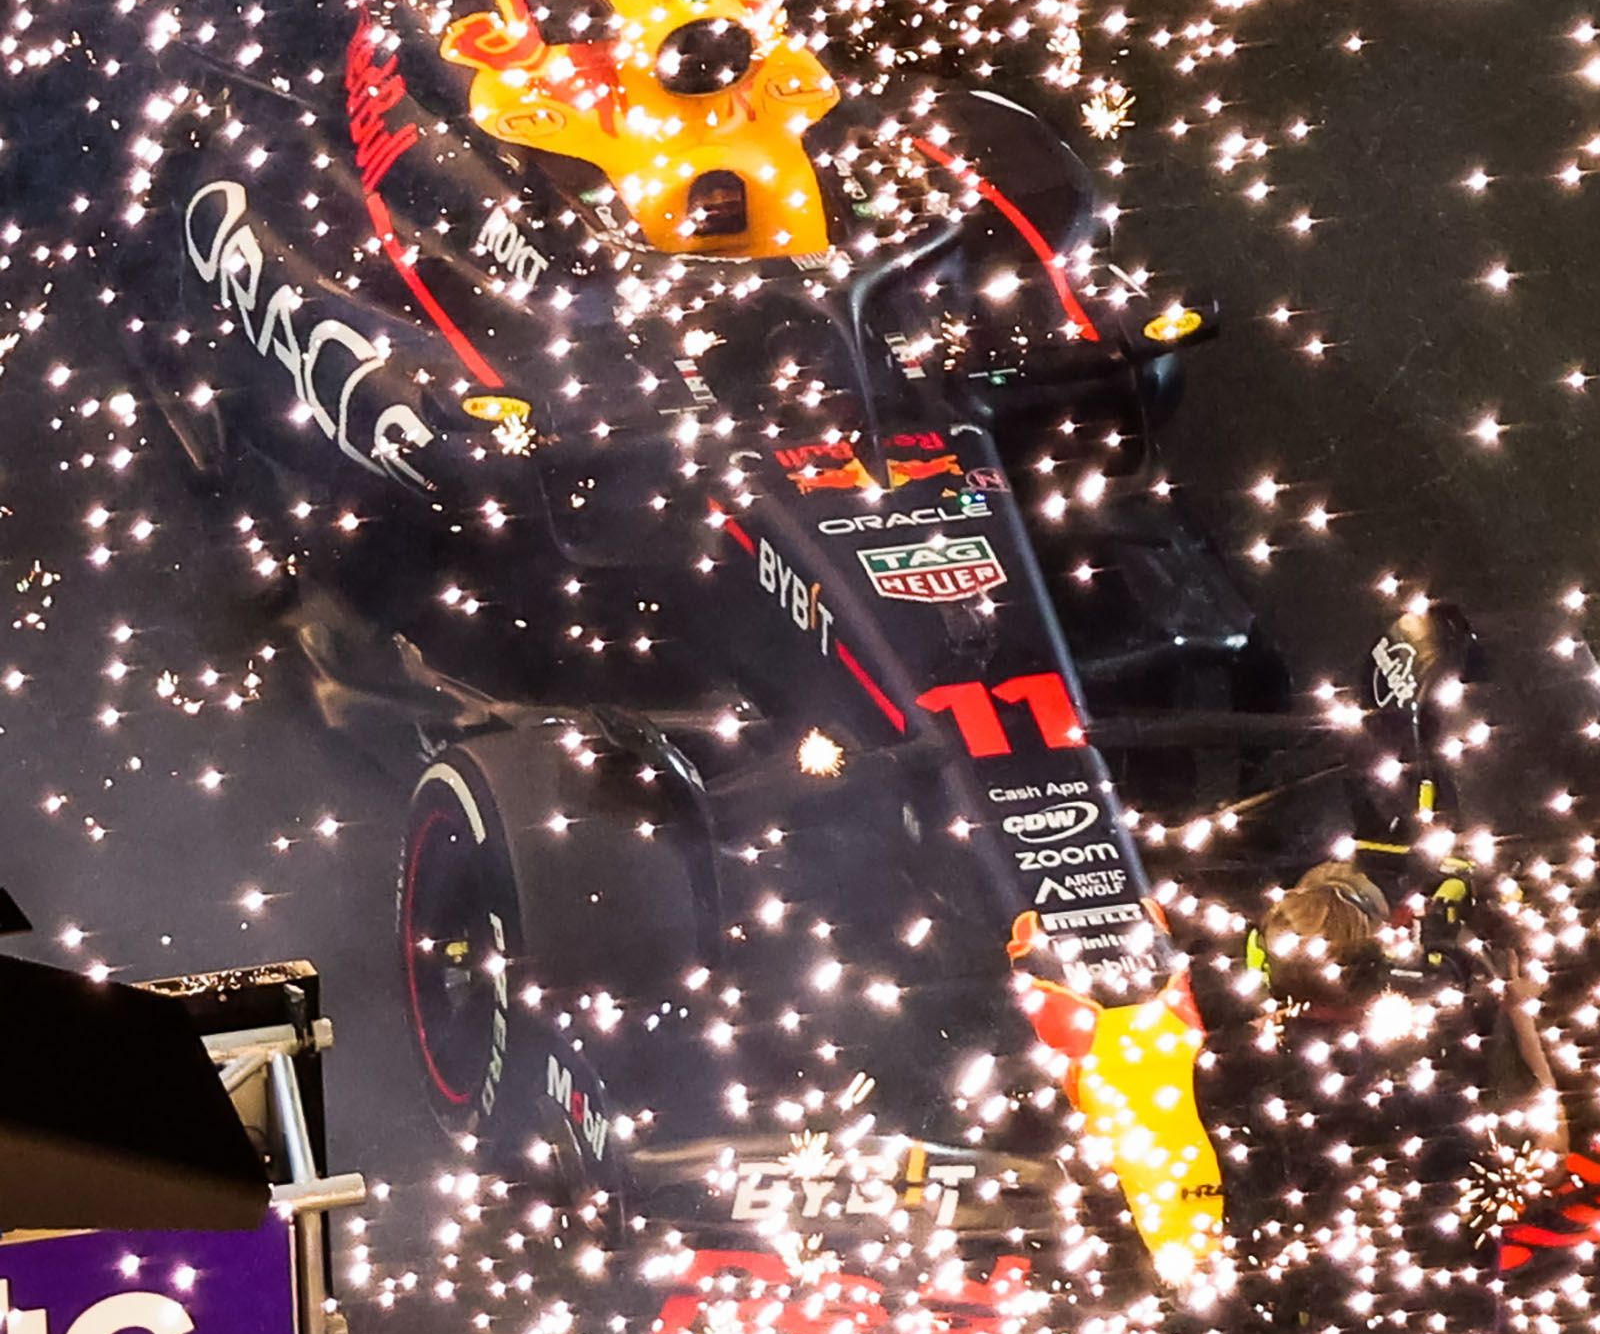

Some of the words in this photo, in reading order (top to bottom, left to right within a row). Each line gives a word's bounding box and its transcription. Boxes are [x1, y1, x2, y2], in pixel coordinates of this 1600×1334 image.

[818, 501, 993, 535] ORACLE
[871, 543, 983, 569] TAG
[880, 566, 998, 596] HEUER
[759, 536, 835, 657] BYBIT
[915, 672, 1088, 758] 11
[988, 785, 1042, 803] Cash
[1045, 781, 1089, 798] App
[1002, 809, 1077, 835] CDW
[1015, 842, 1120, 871] zoom
[1063, 868, 1127, 888] ARCTIC
[1074, 881, 1125, 899] WOLF
[1040, 903, 1144, 932] PIRELLI
